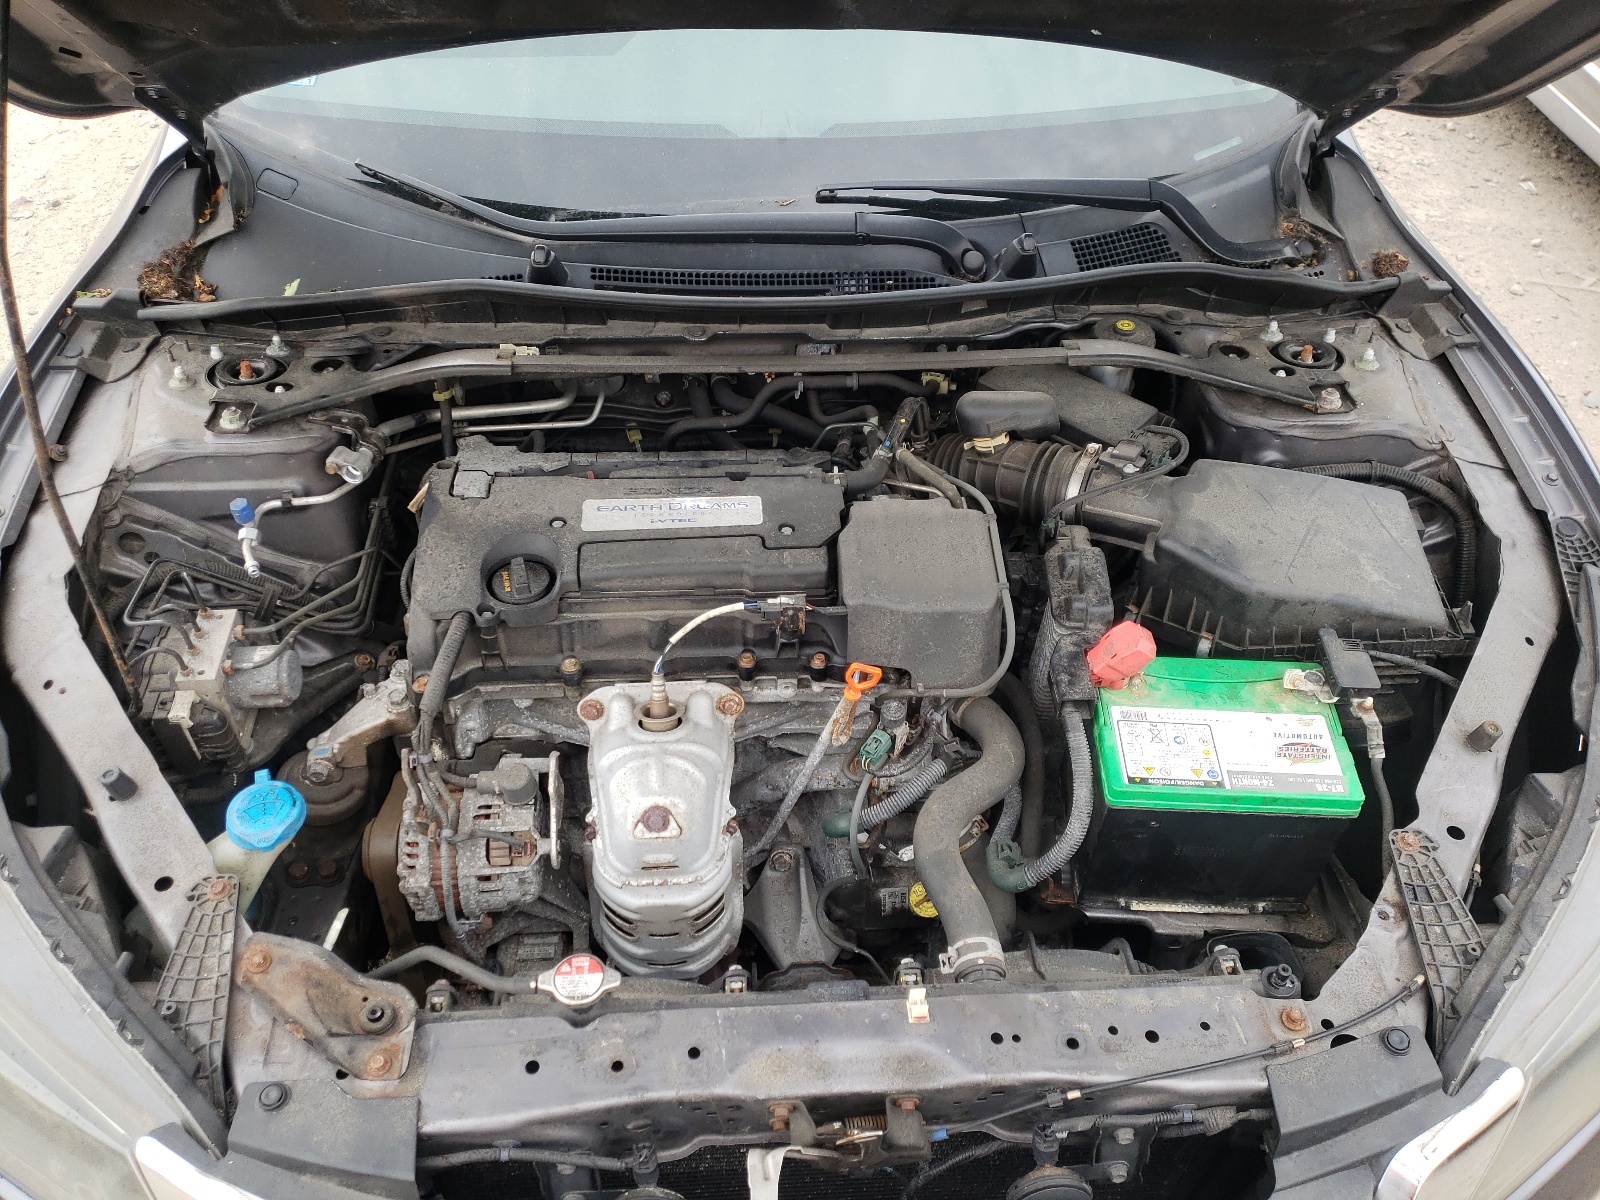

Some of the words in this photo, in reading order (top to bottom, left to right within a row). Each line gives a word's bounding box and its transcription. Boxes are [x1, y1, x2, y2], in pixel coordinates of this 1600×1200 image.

[596, 504, 663, 512] EARTH
[1273, 732, 1323, 740] AUTOMOTIVE
[1277, 746, 1328, 754] BATTERIES
[1276, 752, 1331, 760] INTERSTATE
[1231, 777, 1275, 787] 24-MONTH
